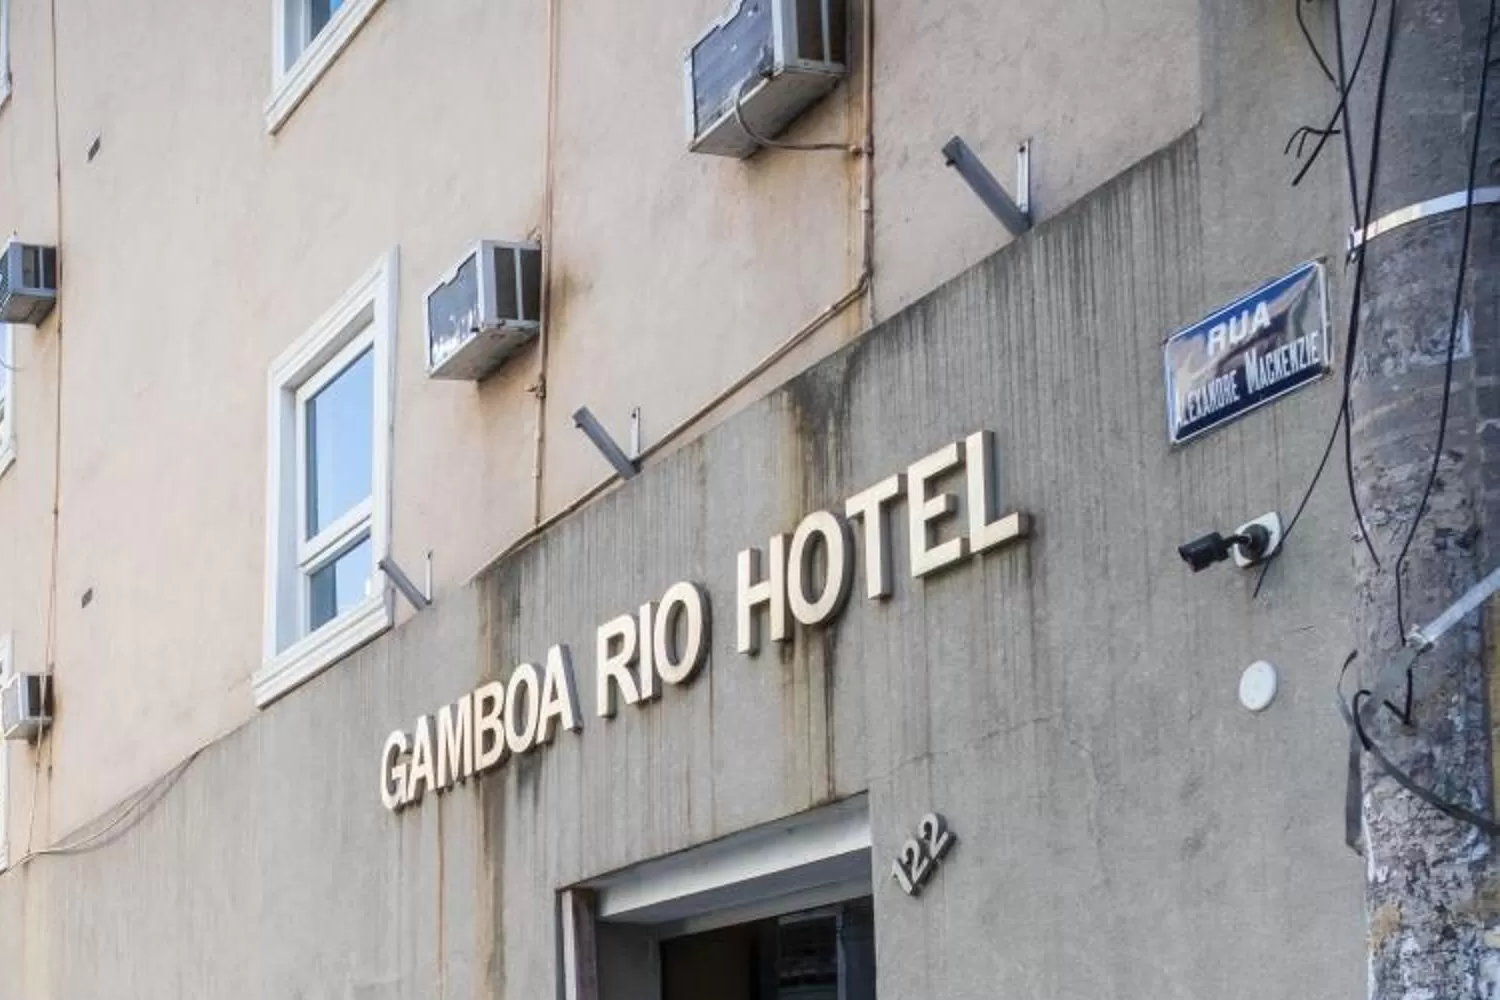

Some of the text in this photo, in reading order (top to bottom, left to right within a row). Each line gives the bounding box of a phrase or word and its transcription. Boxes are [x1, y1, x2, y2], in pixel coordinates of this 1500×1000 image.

[1207, 301, 1271, 357] RUA
[379, 429, 1030, 814] GAMBOA RIO HOTEL
[888, 812, 957, 898] 122
